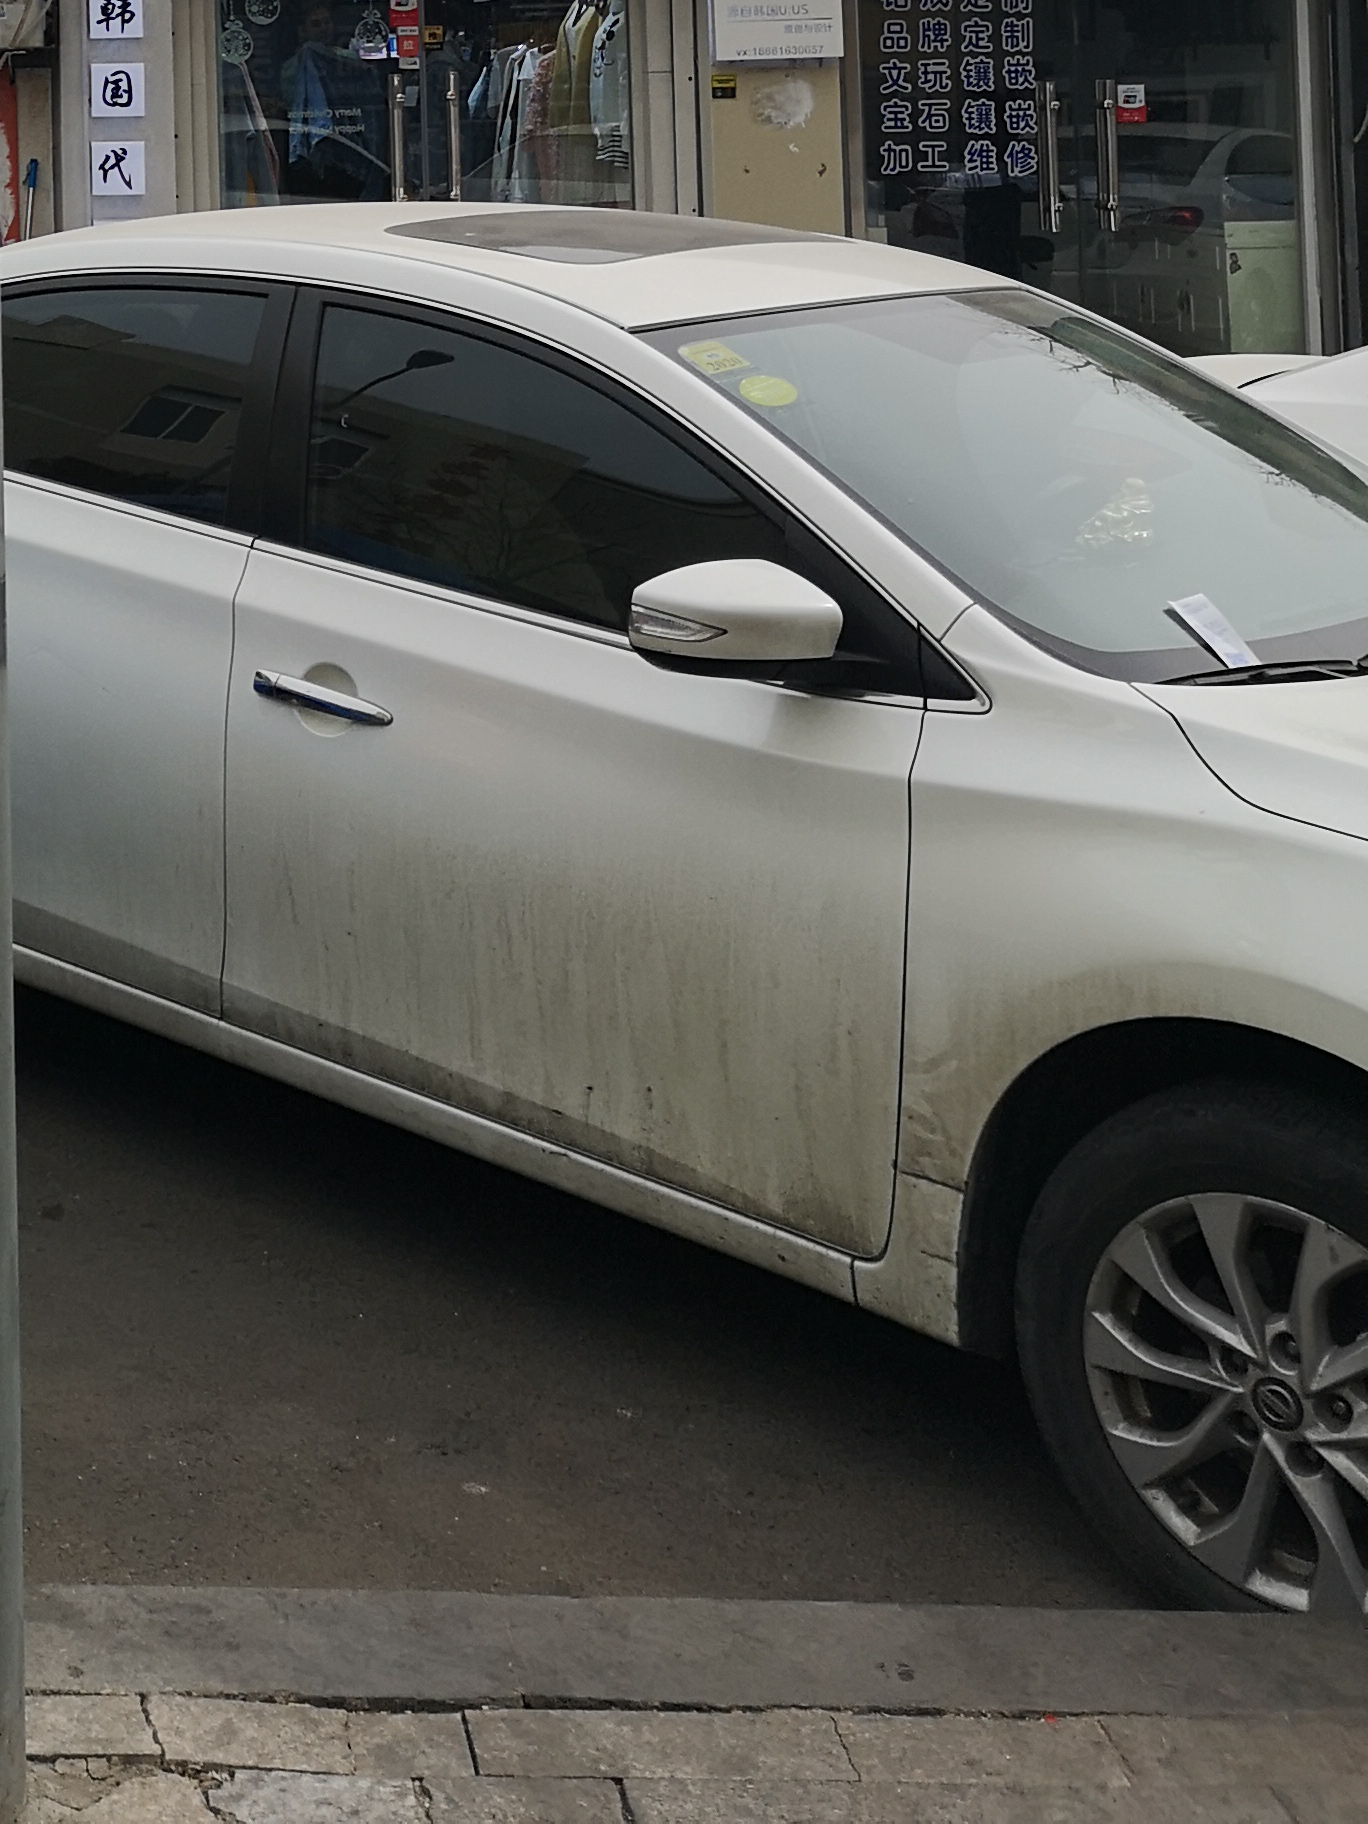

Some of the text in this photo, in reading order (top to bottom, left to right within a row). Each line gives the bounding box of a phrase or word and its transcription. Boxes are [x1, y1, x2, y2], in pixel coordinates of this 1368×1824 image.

[880, 17, 1033, 52] 品牌定制
[880, 55, 1036, 94] 文玩镶嵌
[881, 98, 1037, 134] 宝石镶嵌
[880, 140, 1037, 176] 加工维修
